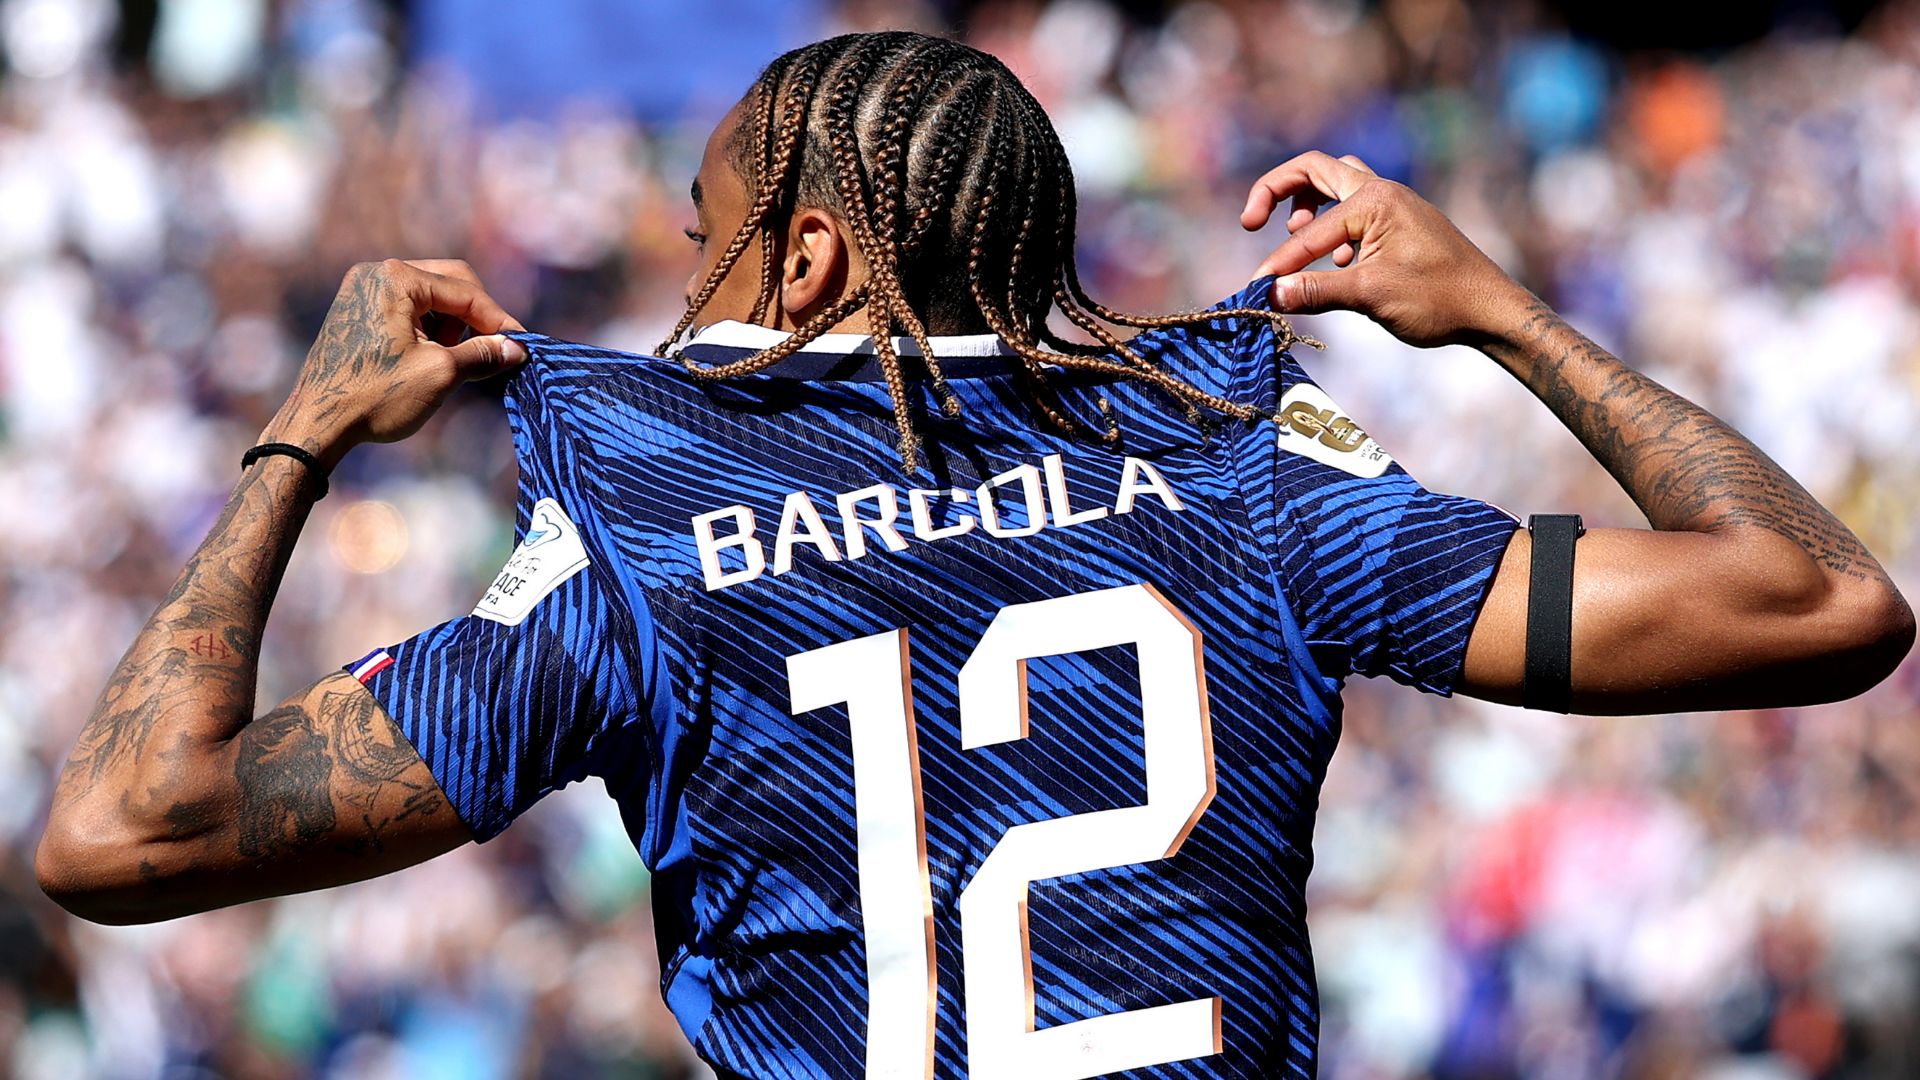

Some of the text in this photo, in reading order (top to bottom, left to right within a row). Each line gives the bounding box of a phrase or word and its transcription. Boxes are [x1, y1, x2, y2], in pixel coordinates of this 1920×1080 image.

[691, 453, 1187, 592] BARCOLA
[484, 592, 499, 606] FA
[491, 570, 527, 597] ACE
[785, 582, 1224, 1080] 12
